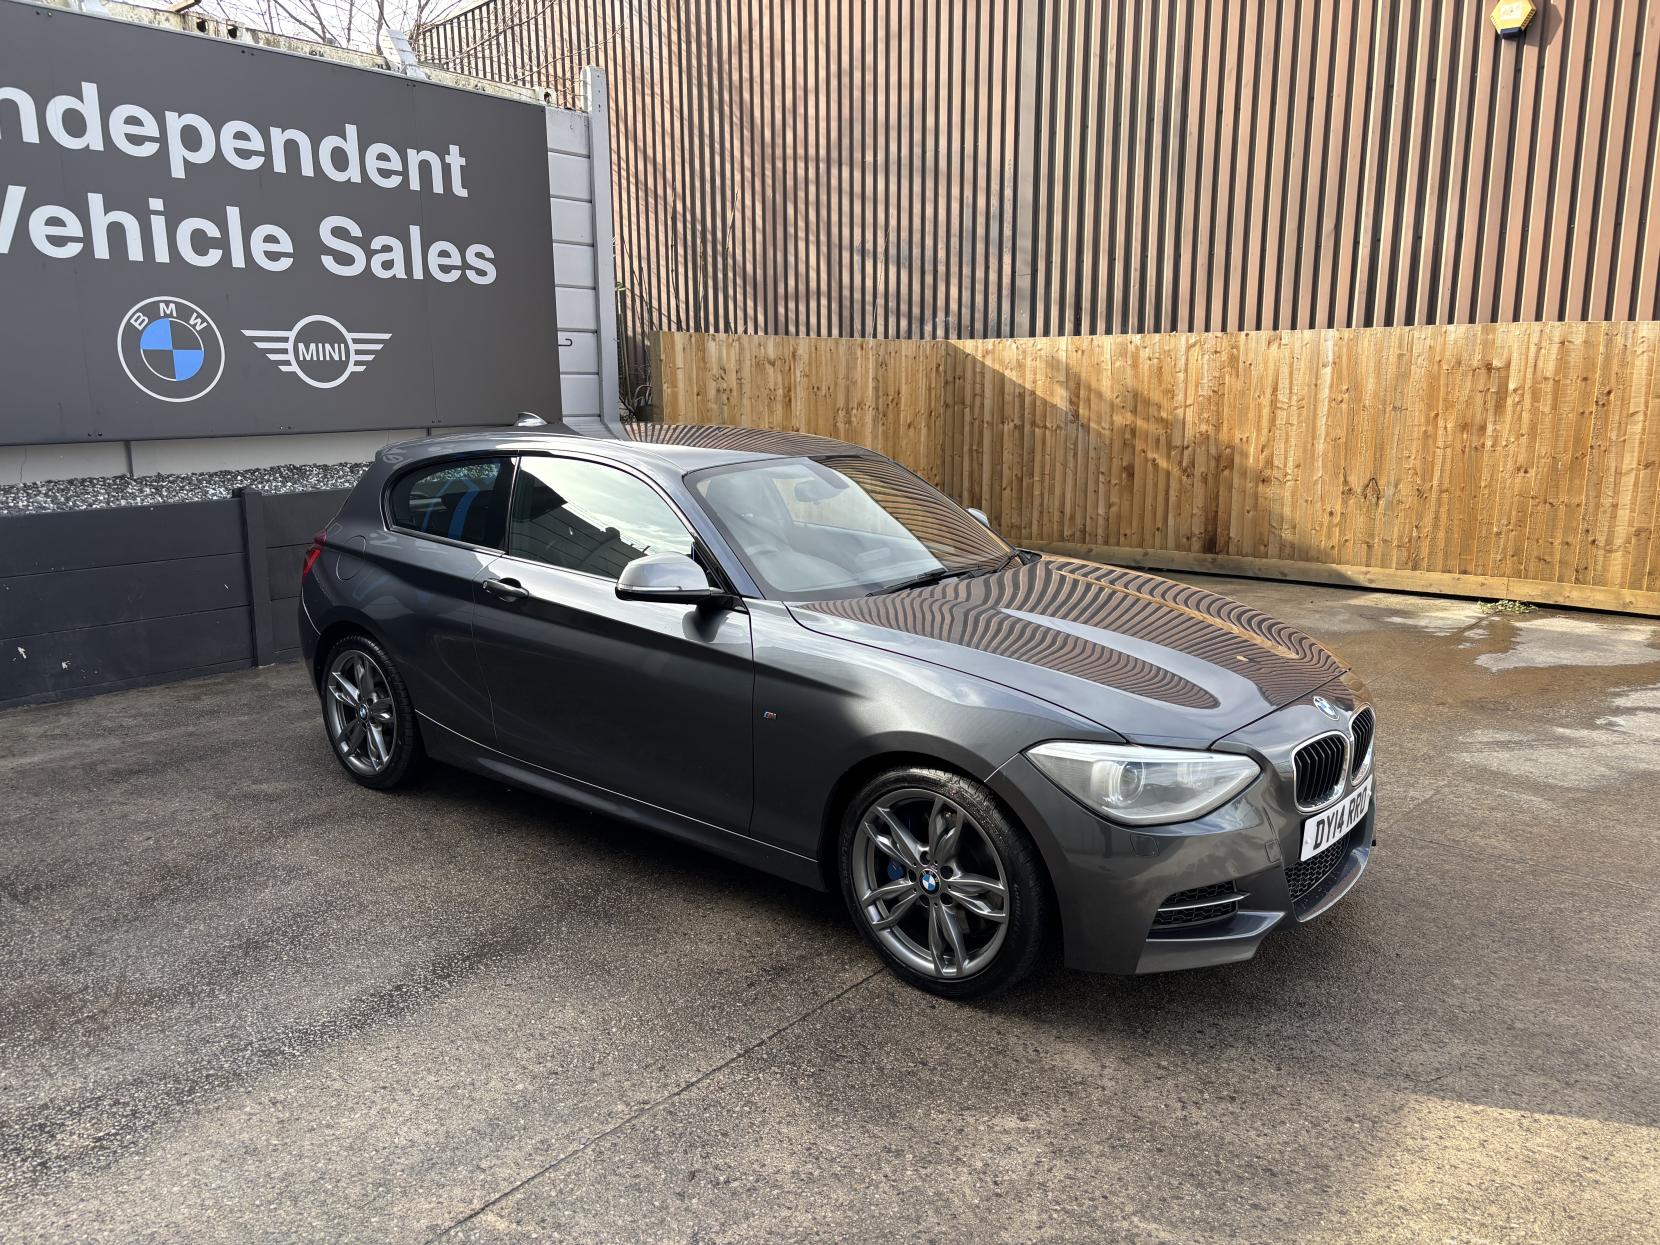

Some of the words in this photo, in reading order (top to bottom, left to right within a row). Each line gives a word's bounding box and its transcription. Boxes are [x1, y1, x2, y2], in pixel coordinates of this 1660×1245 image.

[318, 215, 497, 285] Sales
[129, 302, 208, 331] BMW
[297, 342, 346, 361] MINI
[1313, 804, 1346, 851] DY14
